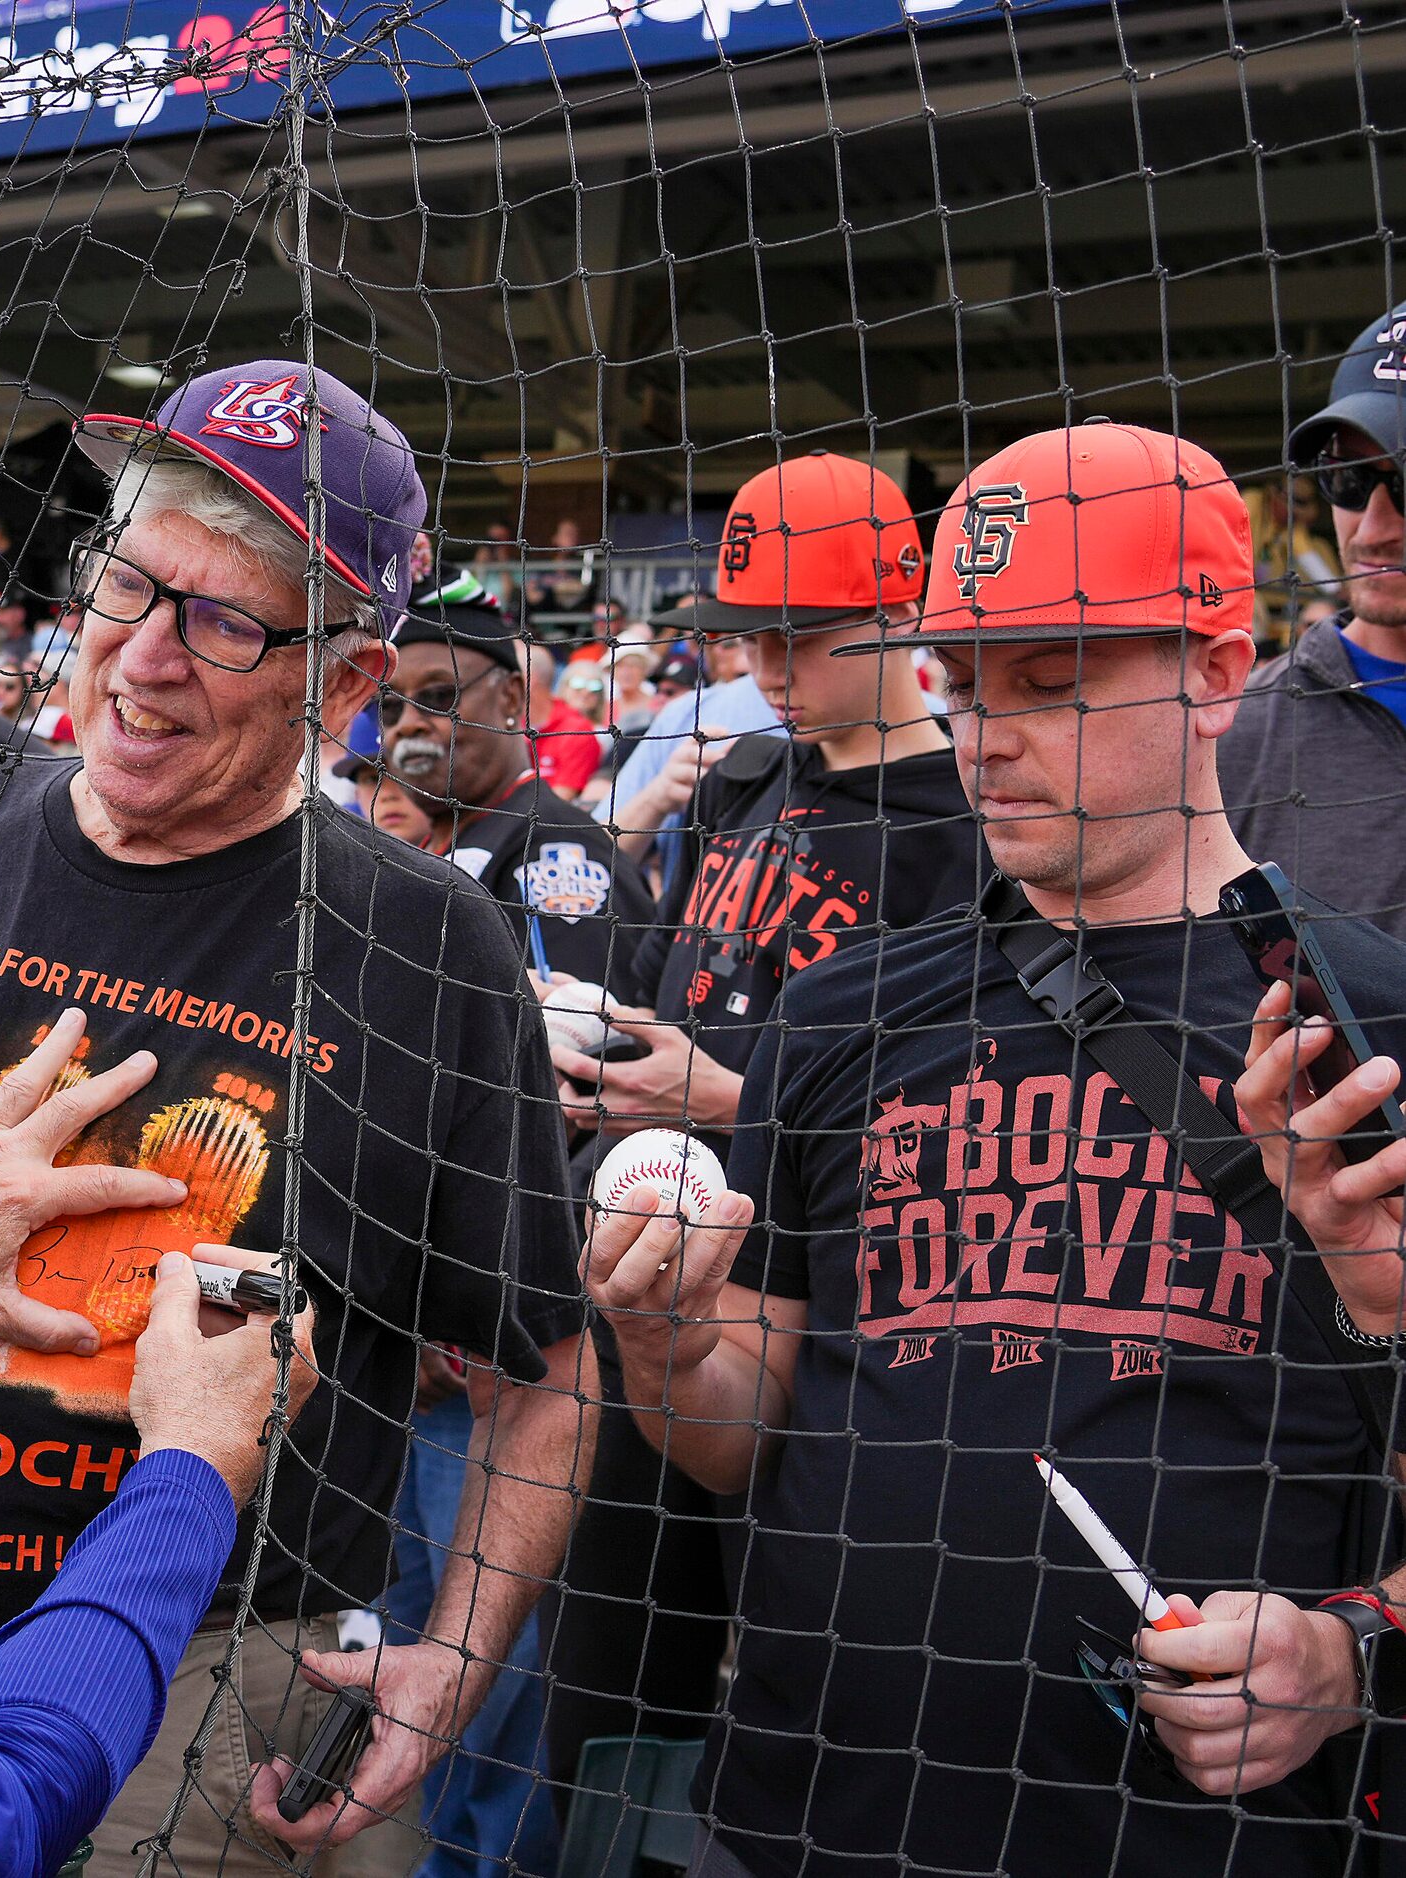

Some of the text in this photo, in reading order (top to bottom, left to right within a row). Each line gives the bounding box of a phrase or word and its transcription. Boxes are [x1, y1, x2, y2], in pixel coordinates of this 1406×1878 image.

[952, 481, 1031, 600] SF
[74, 969, 146, 1013] THE
[144, 986, 340, 1073] MEMORIES
[855, 1181, 1274, 1324] FOREVER
[897, 1336, 928, 1364] 2010
[996, 1331, 1033, 1368] 2012
[1115, 1342, 1154, 1375] 2014
